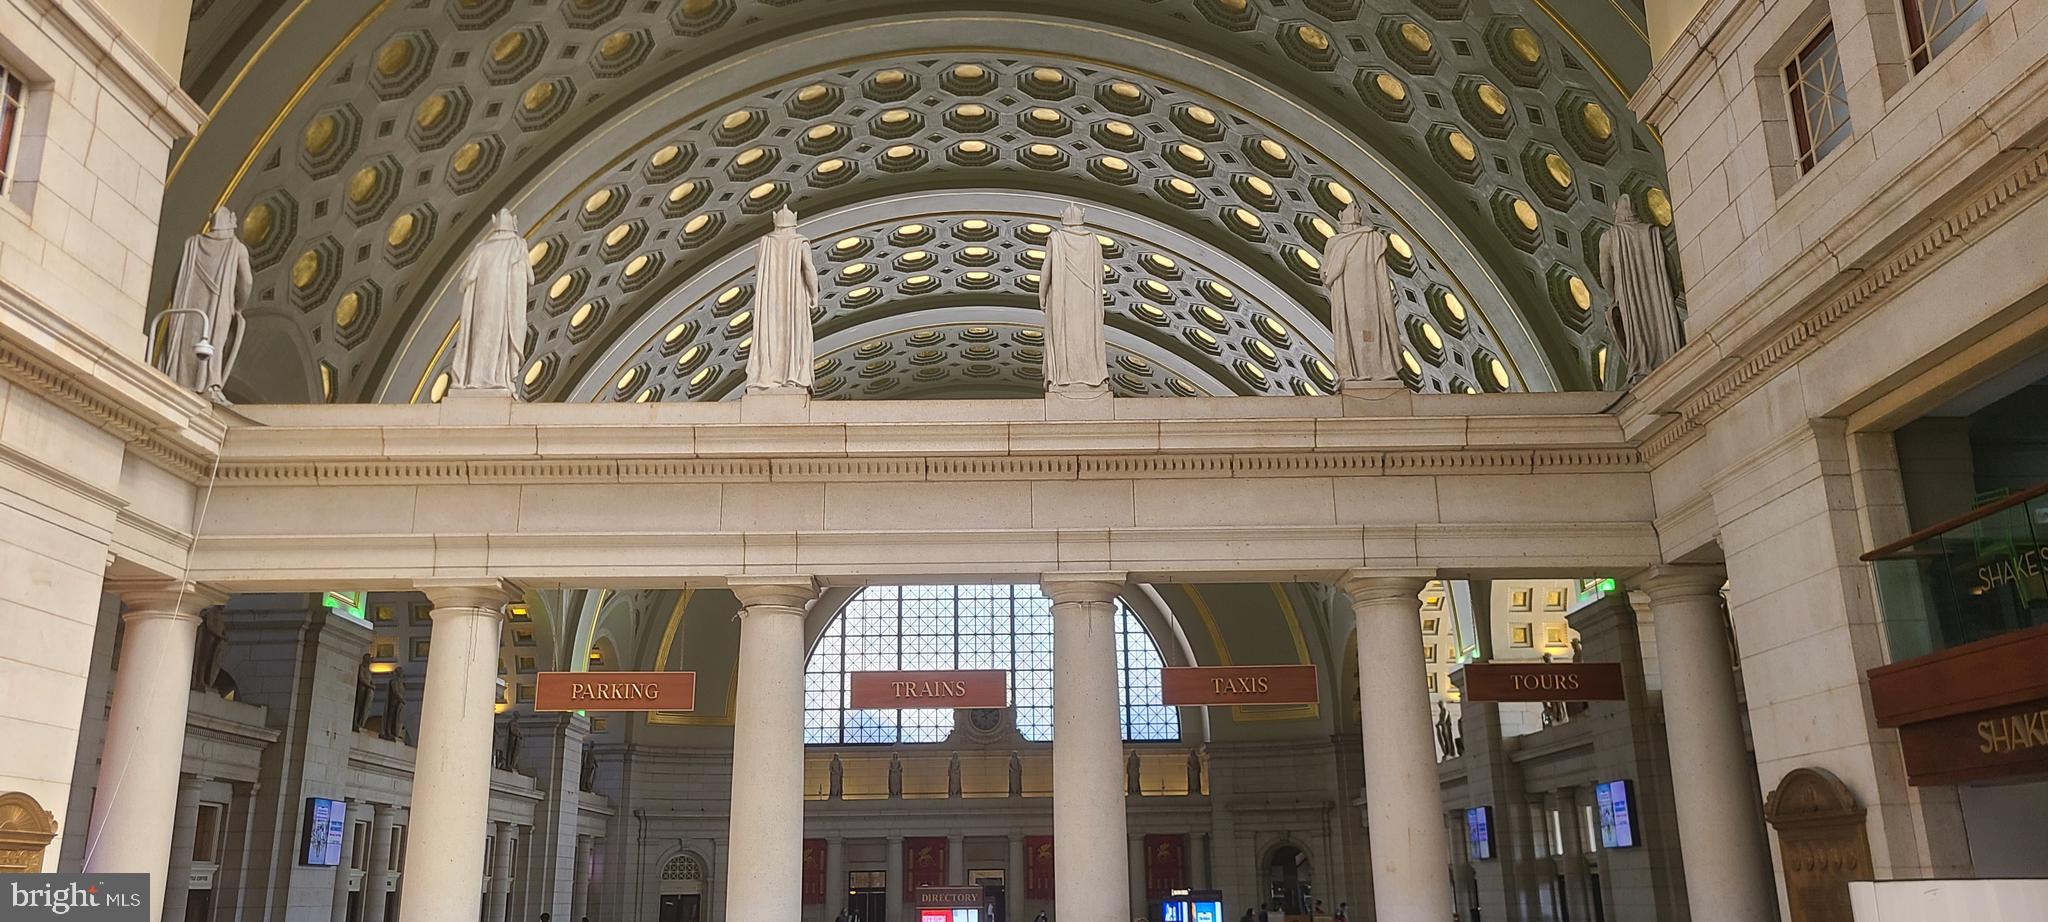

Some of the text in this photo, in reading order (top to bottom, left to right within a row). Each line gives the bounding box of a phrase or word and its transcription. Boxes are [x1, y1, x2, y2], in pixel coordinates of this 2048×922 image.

[571, 682, 661, 700] PARKING
[891, 680, 967, 698] TRAINS
[1210, 676, 1269, 694] TAXIS
[1510, 673, 1580, 691] TOURS
[921, 893, 978, 902] DIRECTORY
